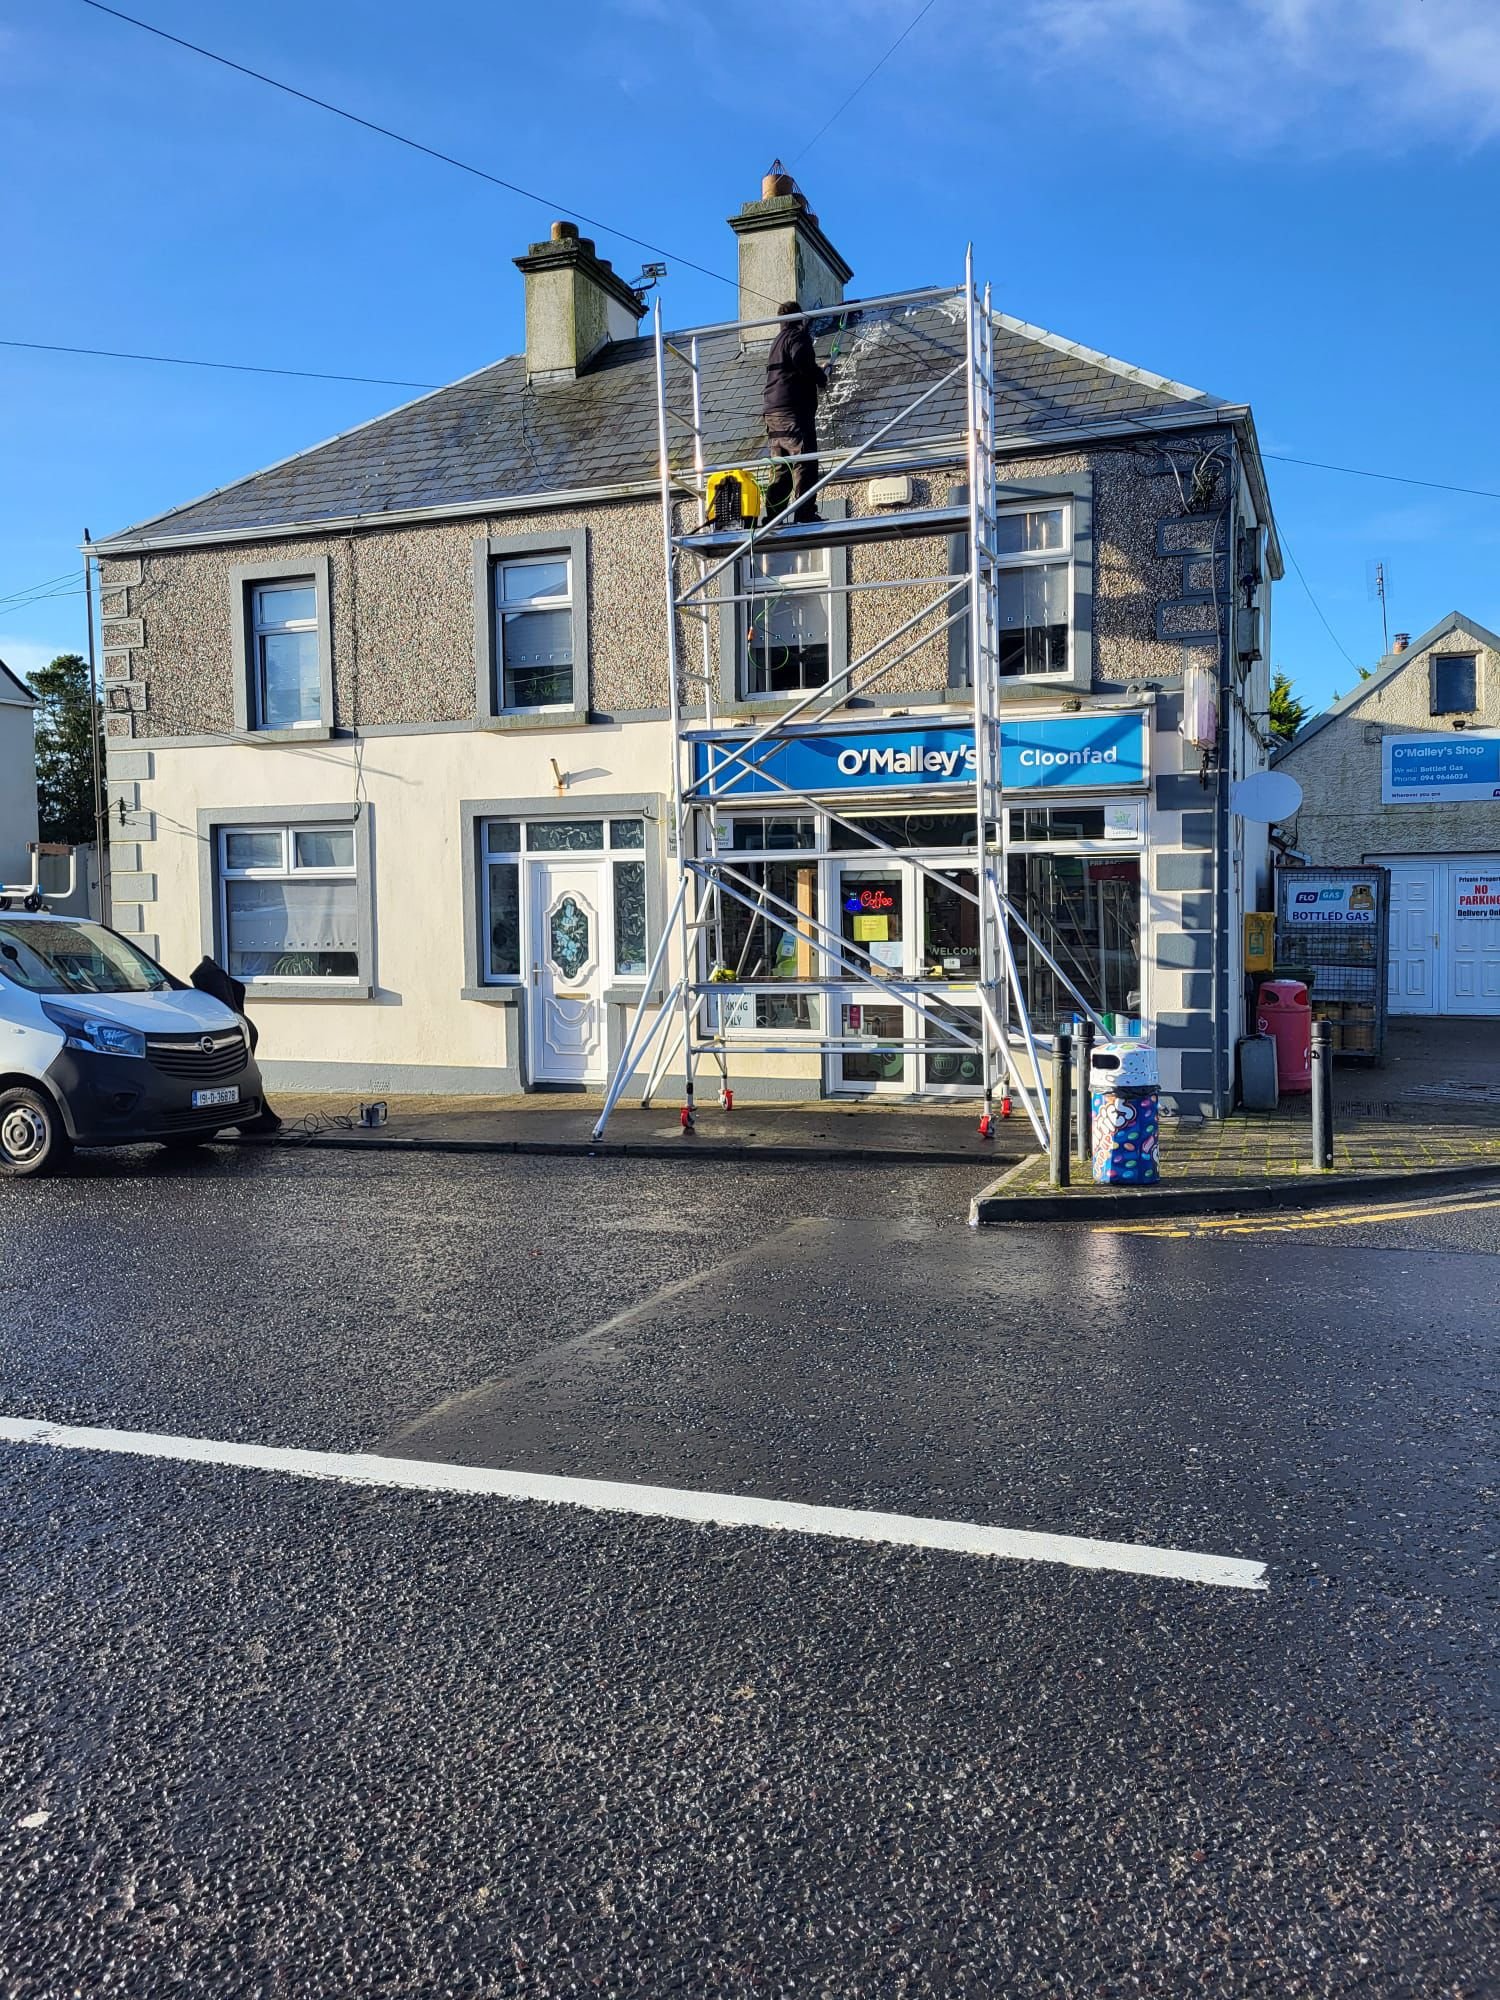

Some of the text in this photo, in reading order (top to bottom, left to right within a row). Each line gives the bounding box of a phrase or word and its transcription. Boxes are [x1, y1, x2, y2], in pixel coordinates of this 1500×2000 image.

[1019, 746, 1117, 766] Cloonfad
[1394, 745, 1484, 758] O'Malley's Shop
[838, 744, 977, 776] O'Malley's
[1420, 764, 1447, 773] Bottled
[1420, 773, 1434, 781] 094
[1474, 884, 1488, 895] NO
[860, 890, 893, 909] Coffee
[1299, 891, 1340, 902] FLO GAS
[1292, 911, 1370, 921] BOTTLED GAS
[1457, 909, 1488, 918] Delivery
[929, 946, 980, 956] WELCOM
